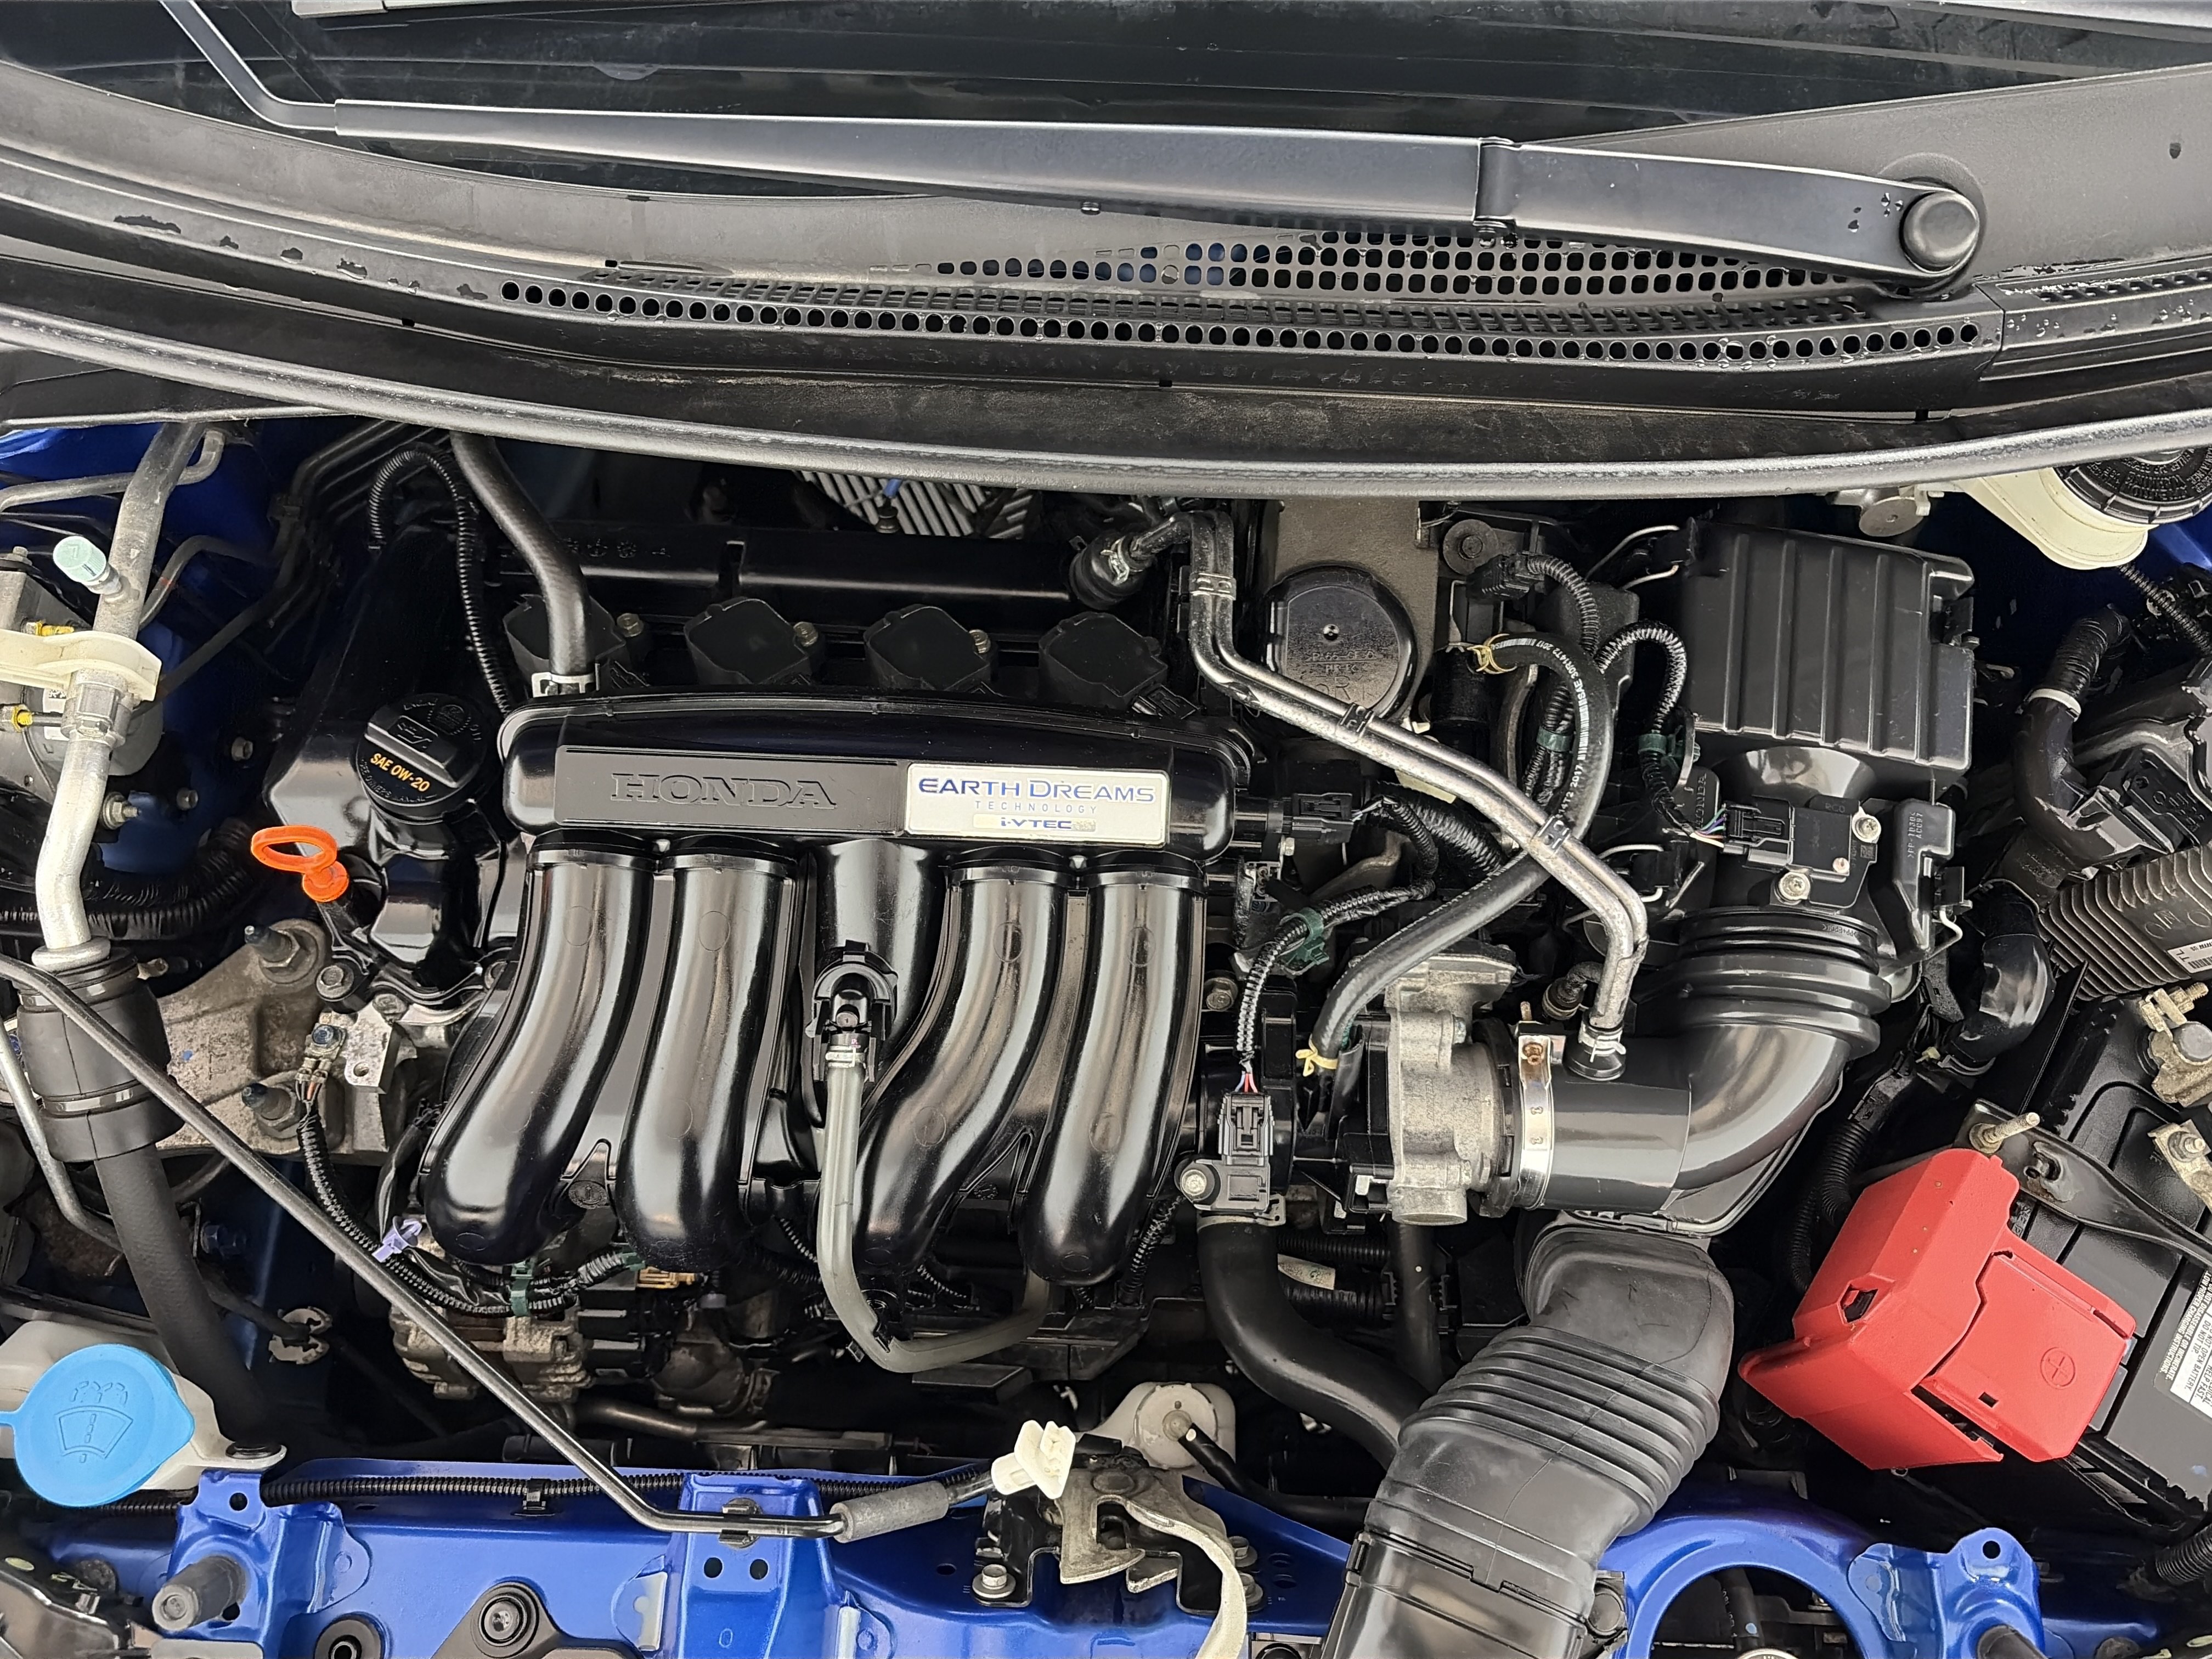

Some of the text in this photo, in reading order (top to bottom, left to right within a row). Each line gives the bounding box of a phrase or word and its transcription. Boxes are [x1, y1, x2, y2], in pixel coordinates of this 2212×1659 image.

[370, 752, 431, 792] SAE 0W-20
[1570, 764, 1584, 788] 2017
[611, 772, 838, 810] HONDA
[918, 777, 1154, 803] EARTH DREAMS
[974, 800, 1097, 814] TECHNOLOGY
[2202, 1291, 2212, 1304] NOT
[2158, 1270, 2212, 1375] LOW PROPER CHARGING INSTRUCTIONS.
[2183, 1302, 2207, 1340] DISASSEMBLE
[2179, 1339, 2190, 1349] OR
[2191, 1319, 2211, 1355] DO NOT TIP.
[2164, 1347, 2186, 1381] INCINERATE.
[2196, 1347, 2209, 1364] OPEN
[2183, 1363, 2202, 1391] BATTERY.
[2194, 1381, 2208, 1400] FAST.
